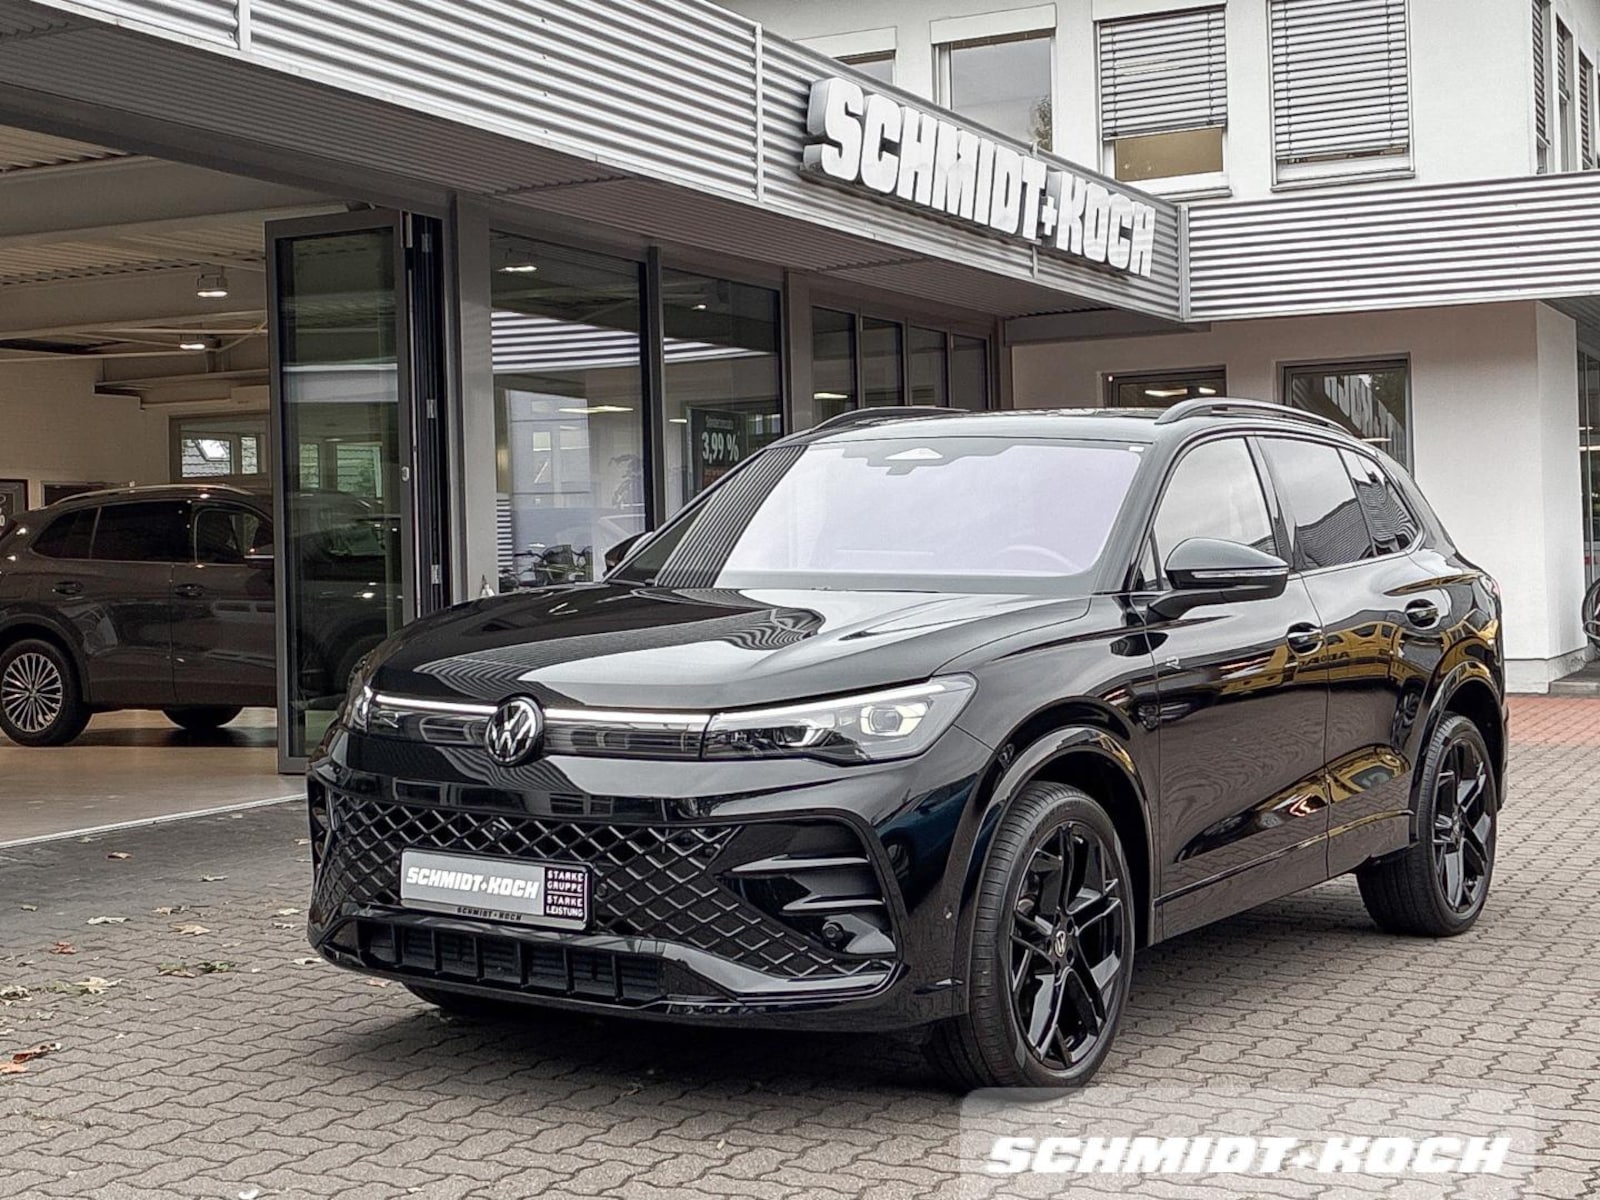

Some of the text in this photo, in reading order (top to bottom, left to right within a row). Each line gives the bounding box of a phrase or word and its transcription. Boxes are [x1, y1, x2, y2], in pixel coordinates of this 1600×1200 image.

[803, 77, 1156, 278] SCHMIDT+KOCH
[701, 431, 724, 464] 3,99
[547, 870, 584, 882] STARKE
[406, 867, 540, 899] SCHMIDT+KOCH
[547, 881, 583, 892] GRUPPE
[546, 894, 583, 907] STARKE
[546, 905, 584, 917] LEISTUNG
